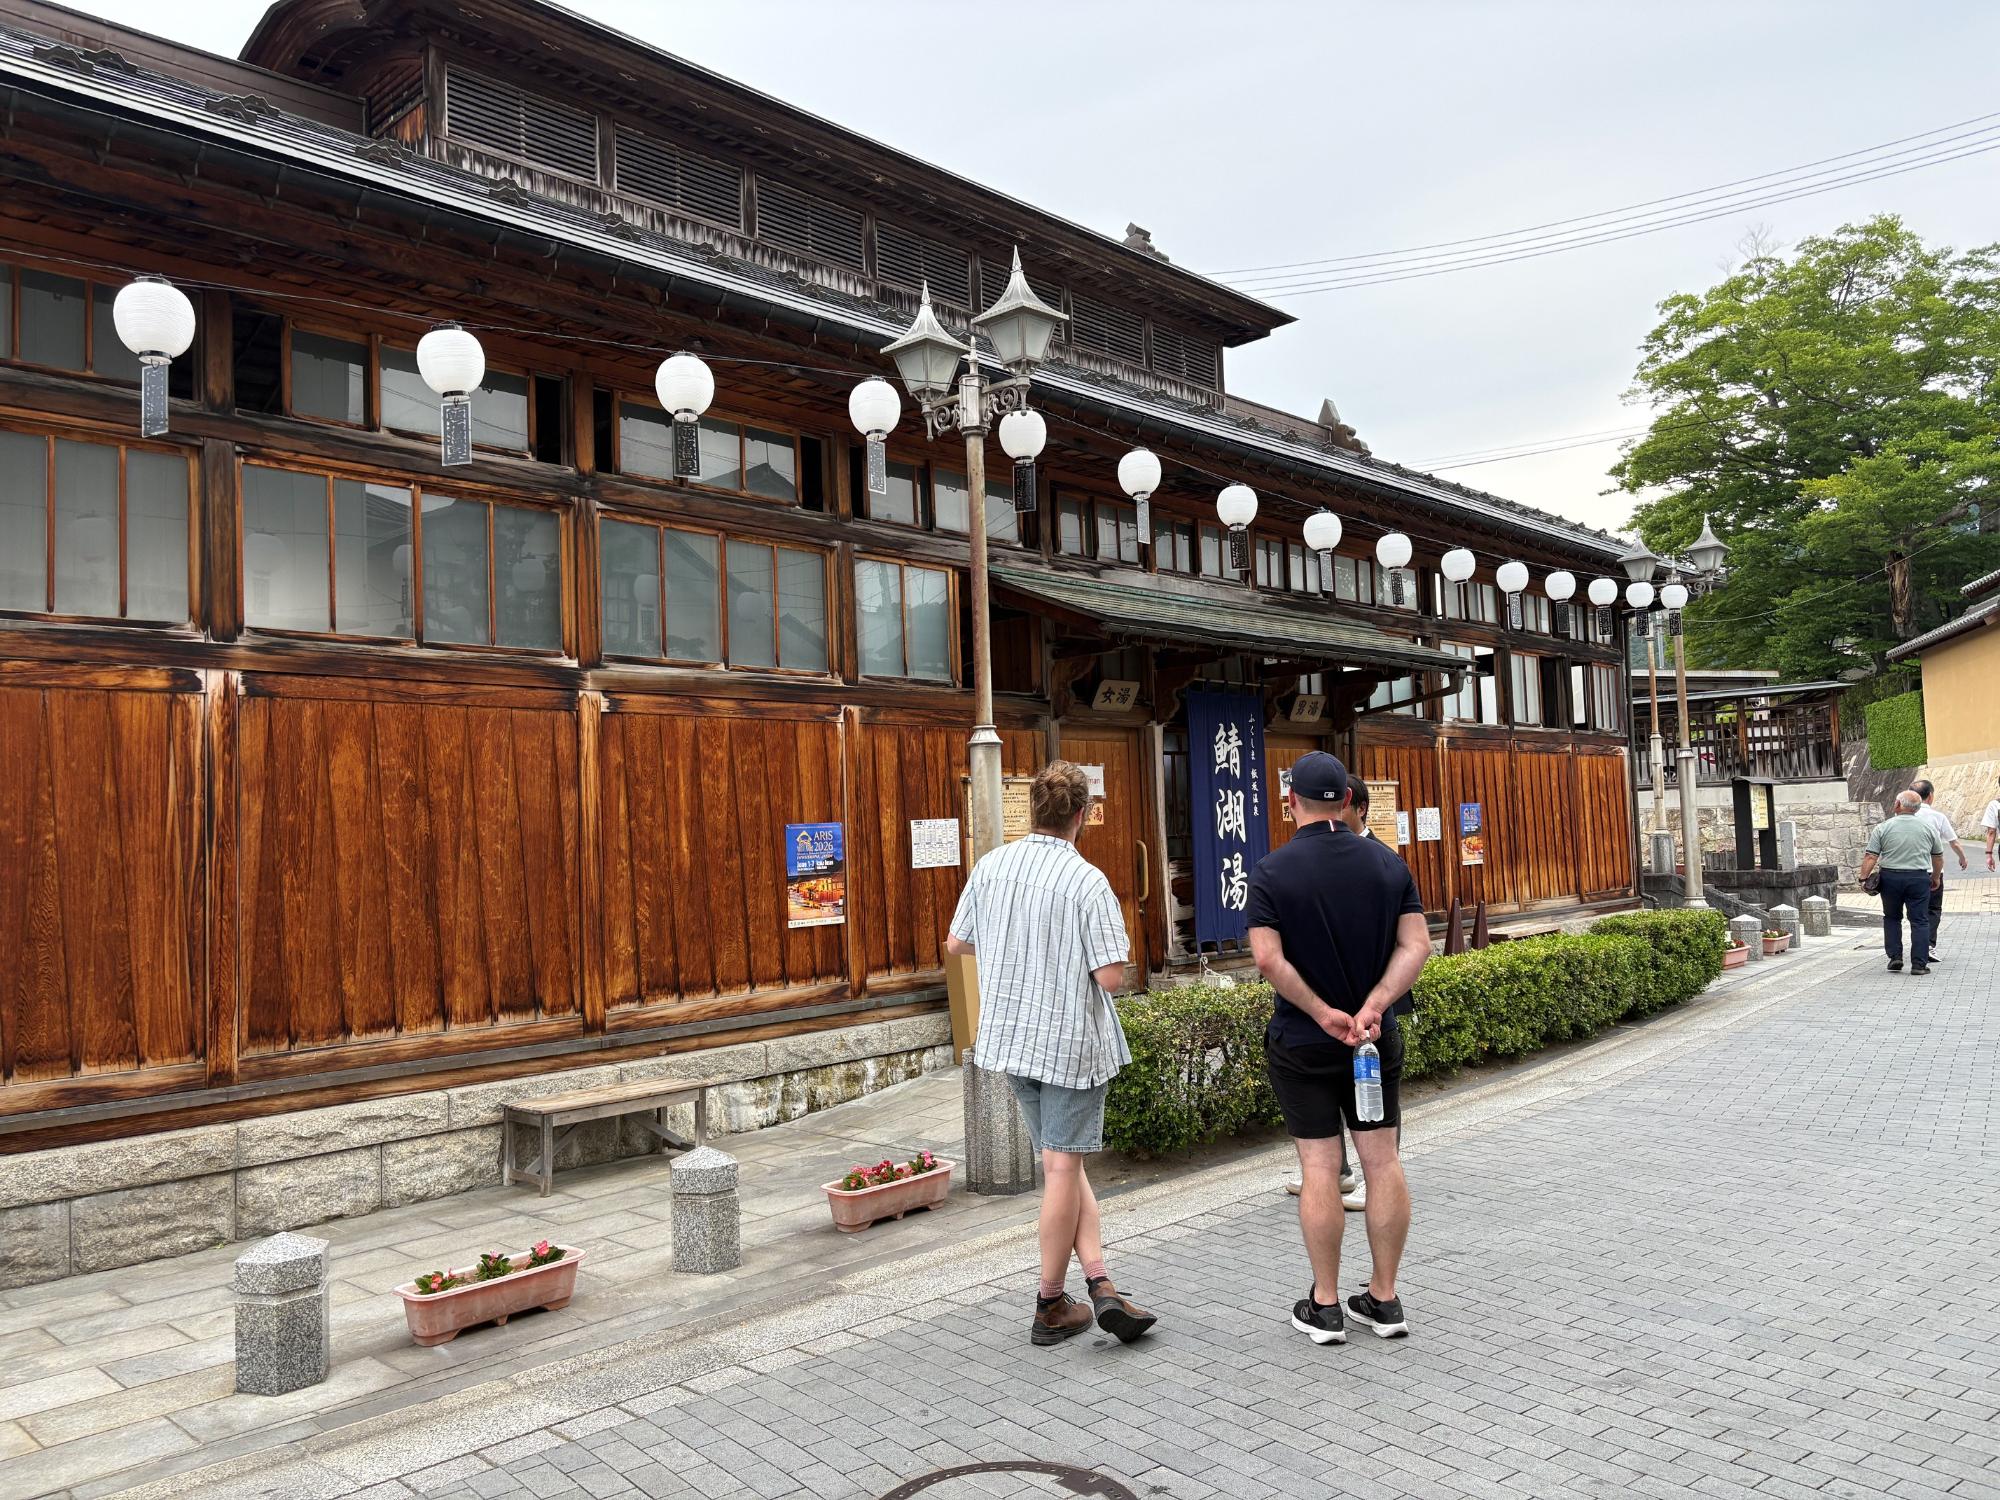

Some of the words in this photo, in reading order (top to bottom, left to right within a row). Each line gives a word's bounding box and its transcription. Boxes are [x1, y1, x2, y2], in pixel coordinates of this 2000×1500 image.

[1101, 686, 1131, 704] 女湯
[1214, 722, 1248, 911] 鯖湖湯
[813, 830, 834, 841] ARIS
[813, 840, 834, 852] 2026
